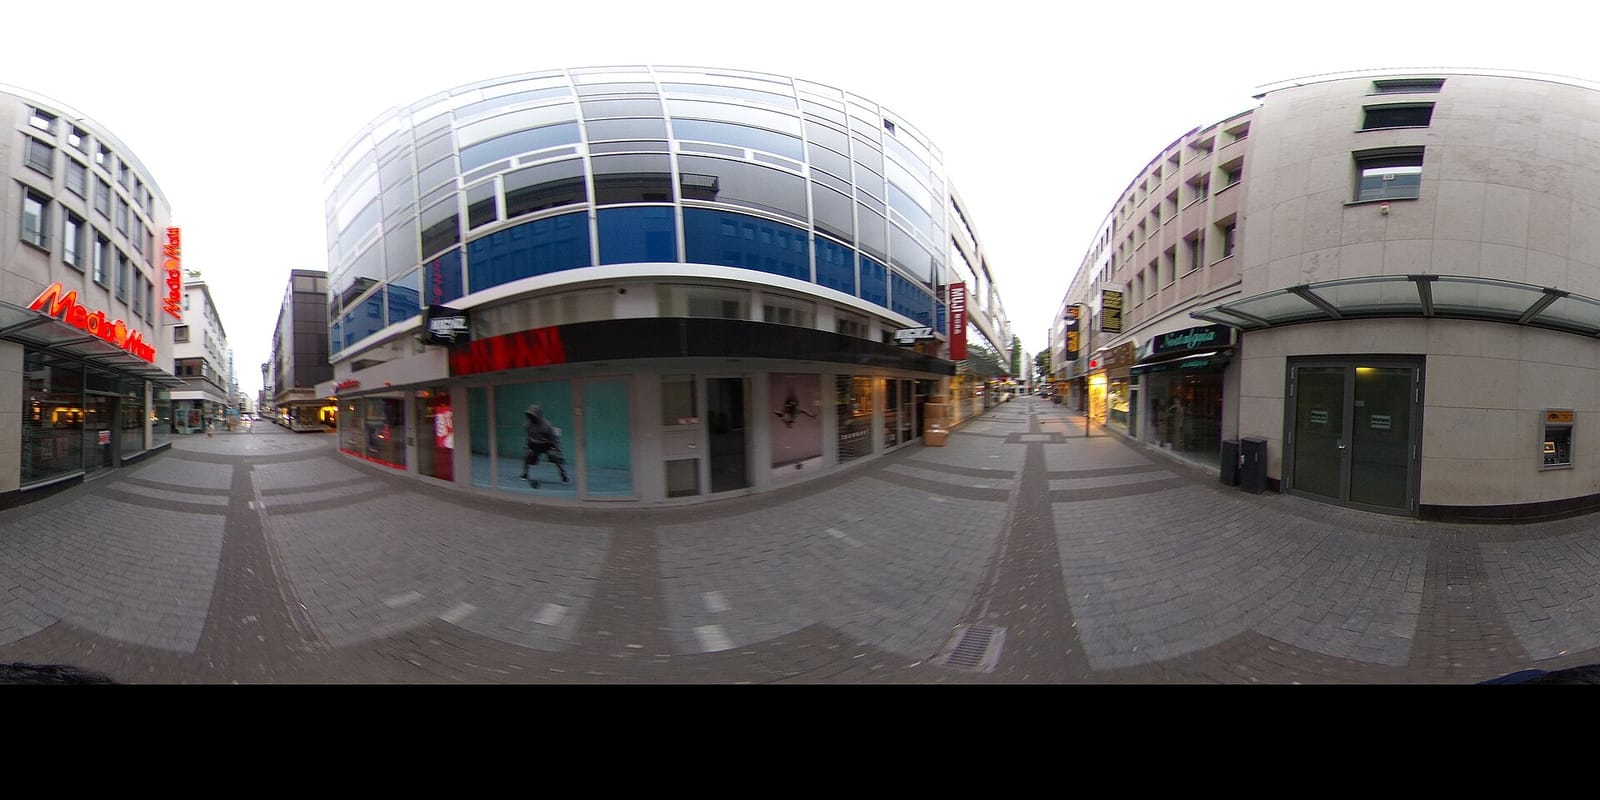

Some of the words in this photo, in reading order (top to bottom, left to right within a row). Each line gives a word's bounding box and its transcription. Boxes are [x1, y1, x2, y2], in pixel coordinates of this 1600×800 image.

[26, 281, 117, 343] Media
[951, 287, 965, 312] MUJI
[1159, 328, 1217, 349] Nostalgia
